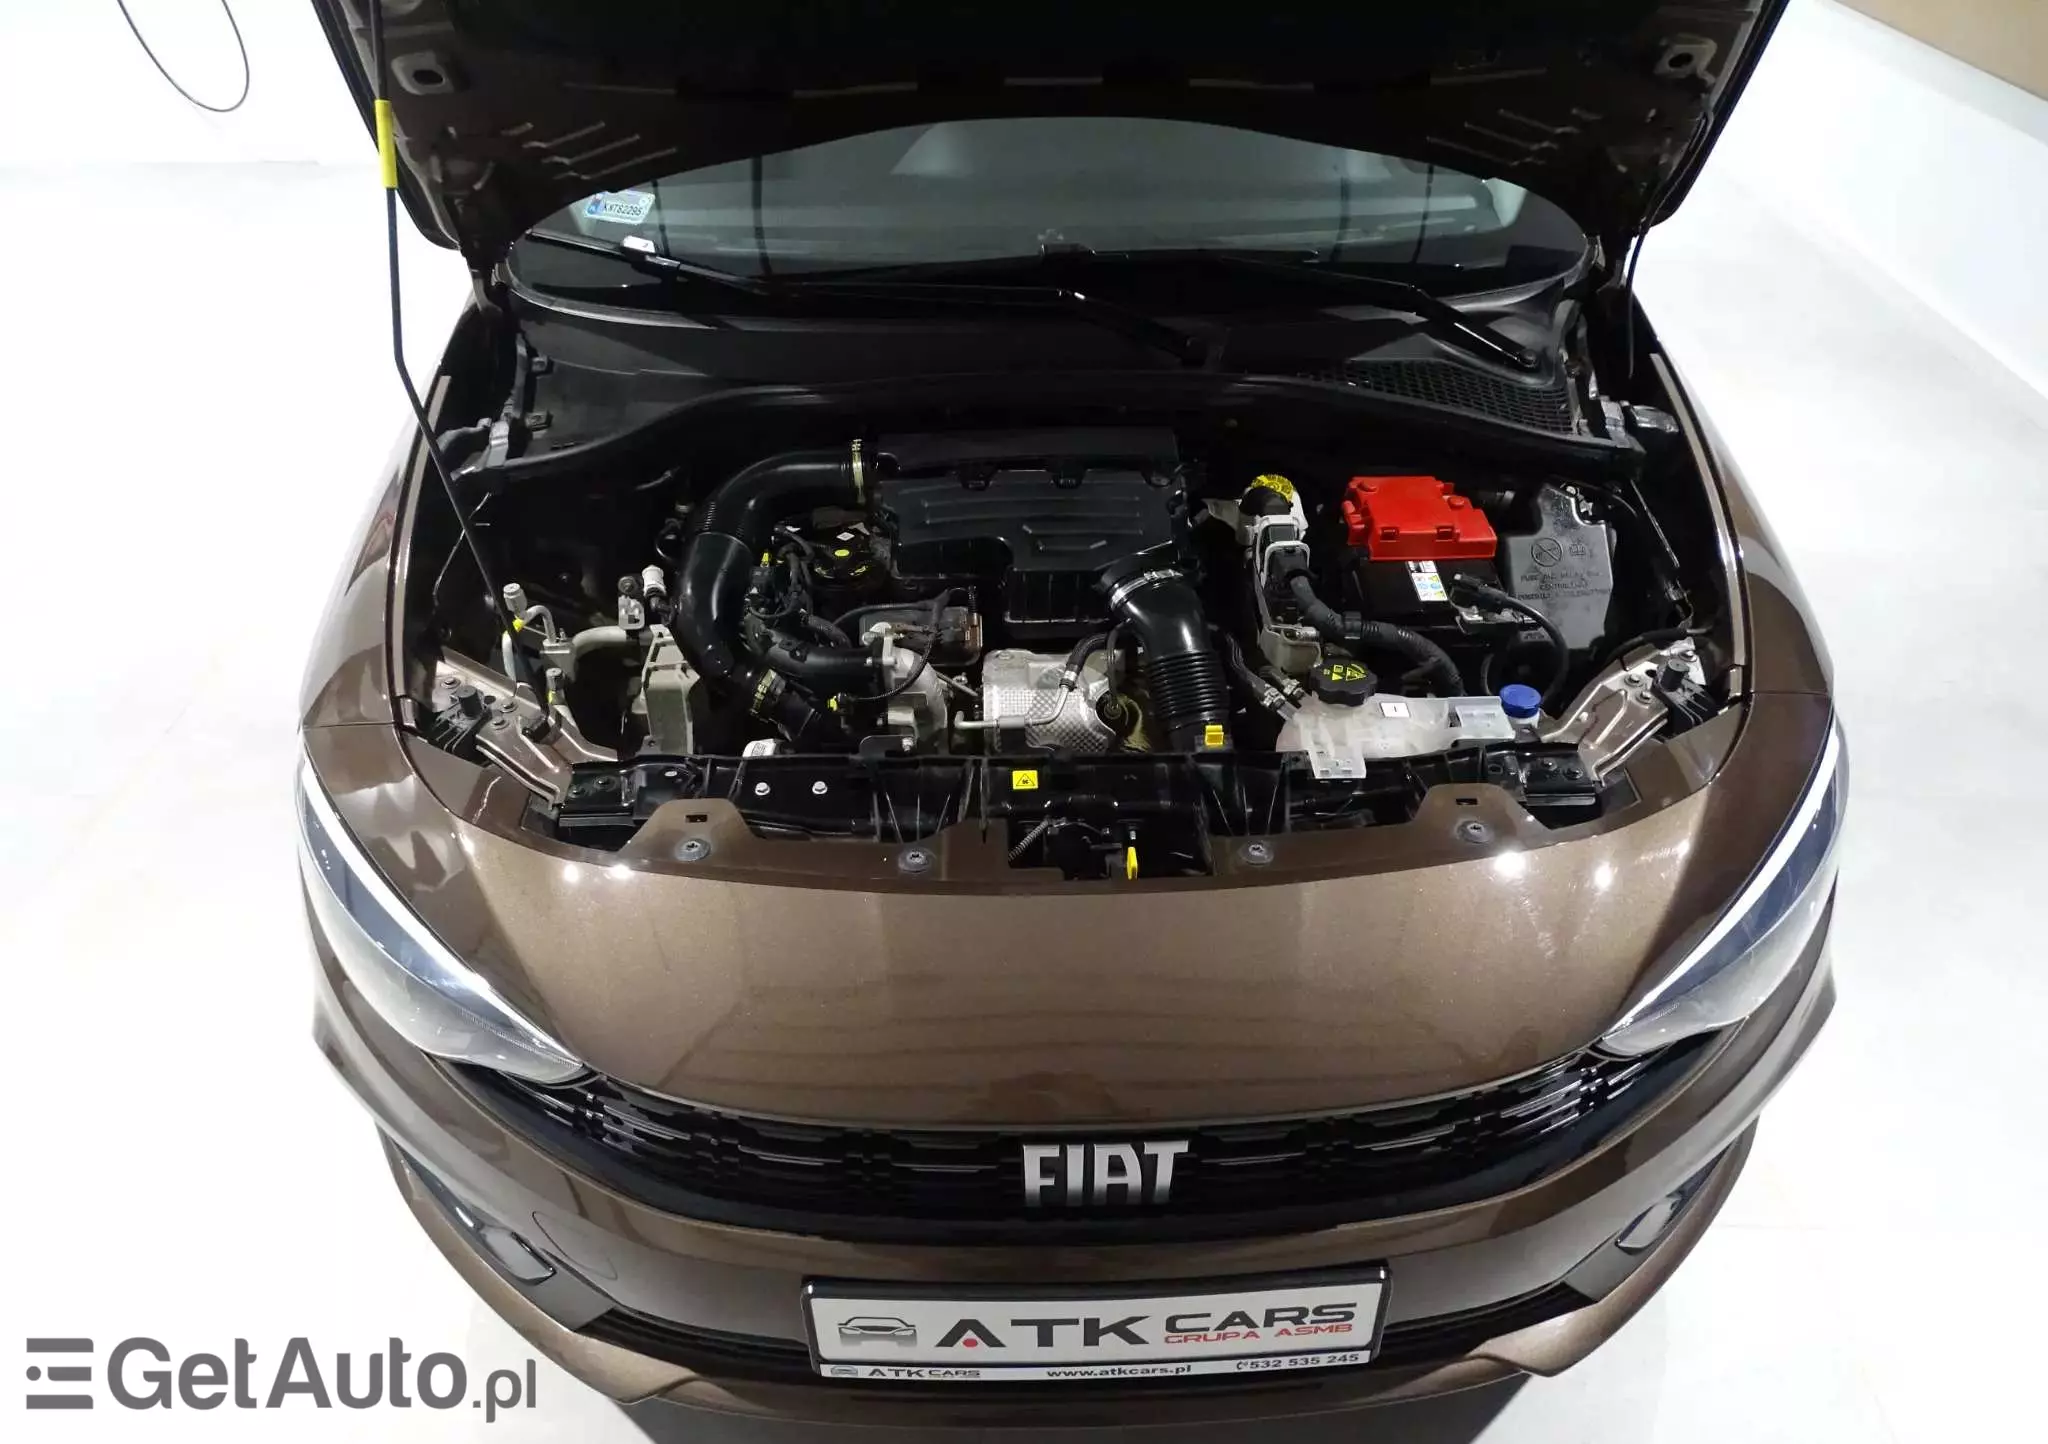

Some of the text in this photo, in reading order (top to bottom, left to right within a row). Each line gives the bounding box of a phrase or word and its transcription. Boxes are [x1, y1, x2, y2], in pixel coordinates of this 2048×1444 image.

[1023, 1140, 1189, 1206] FIAT
[935, 1303, 1357, 1348] ATK CARS
[1164, 1324, 1353, 1344] GRUPA ASMB
[1047, 1364, 1191, 1377] www.atkcars.pl
[1250, 1353, 1358, 1370] 532 535 245
[868, 1368, 980, 1378] ATK CARS
